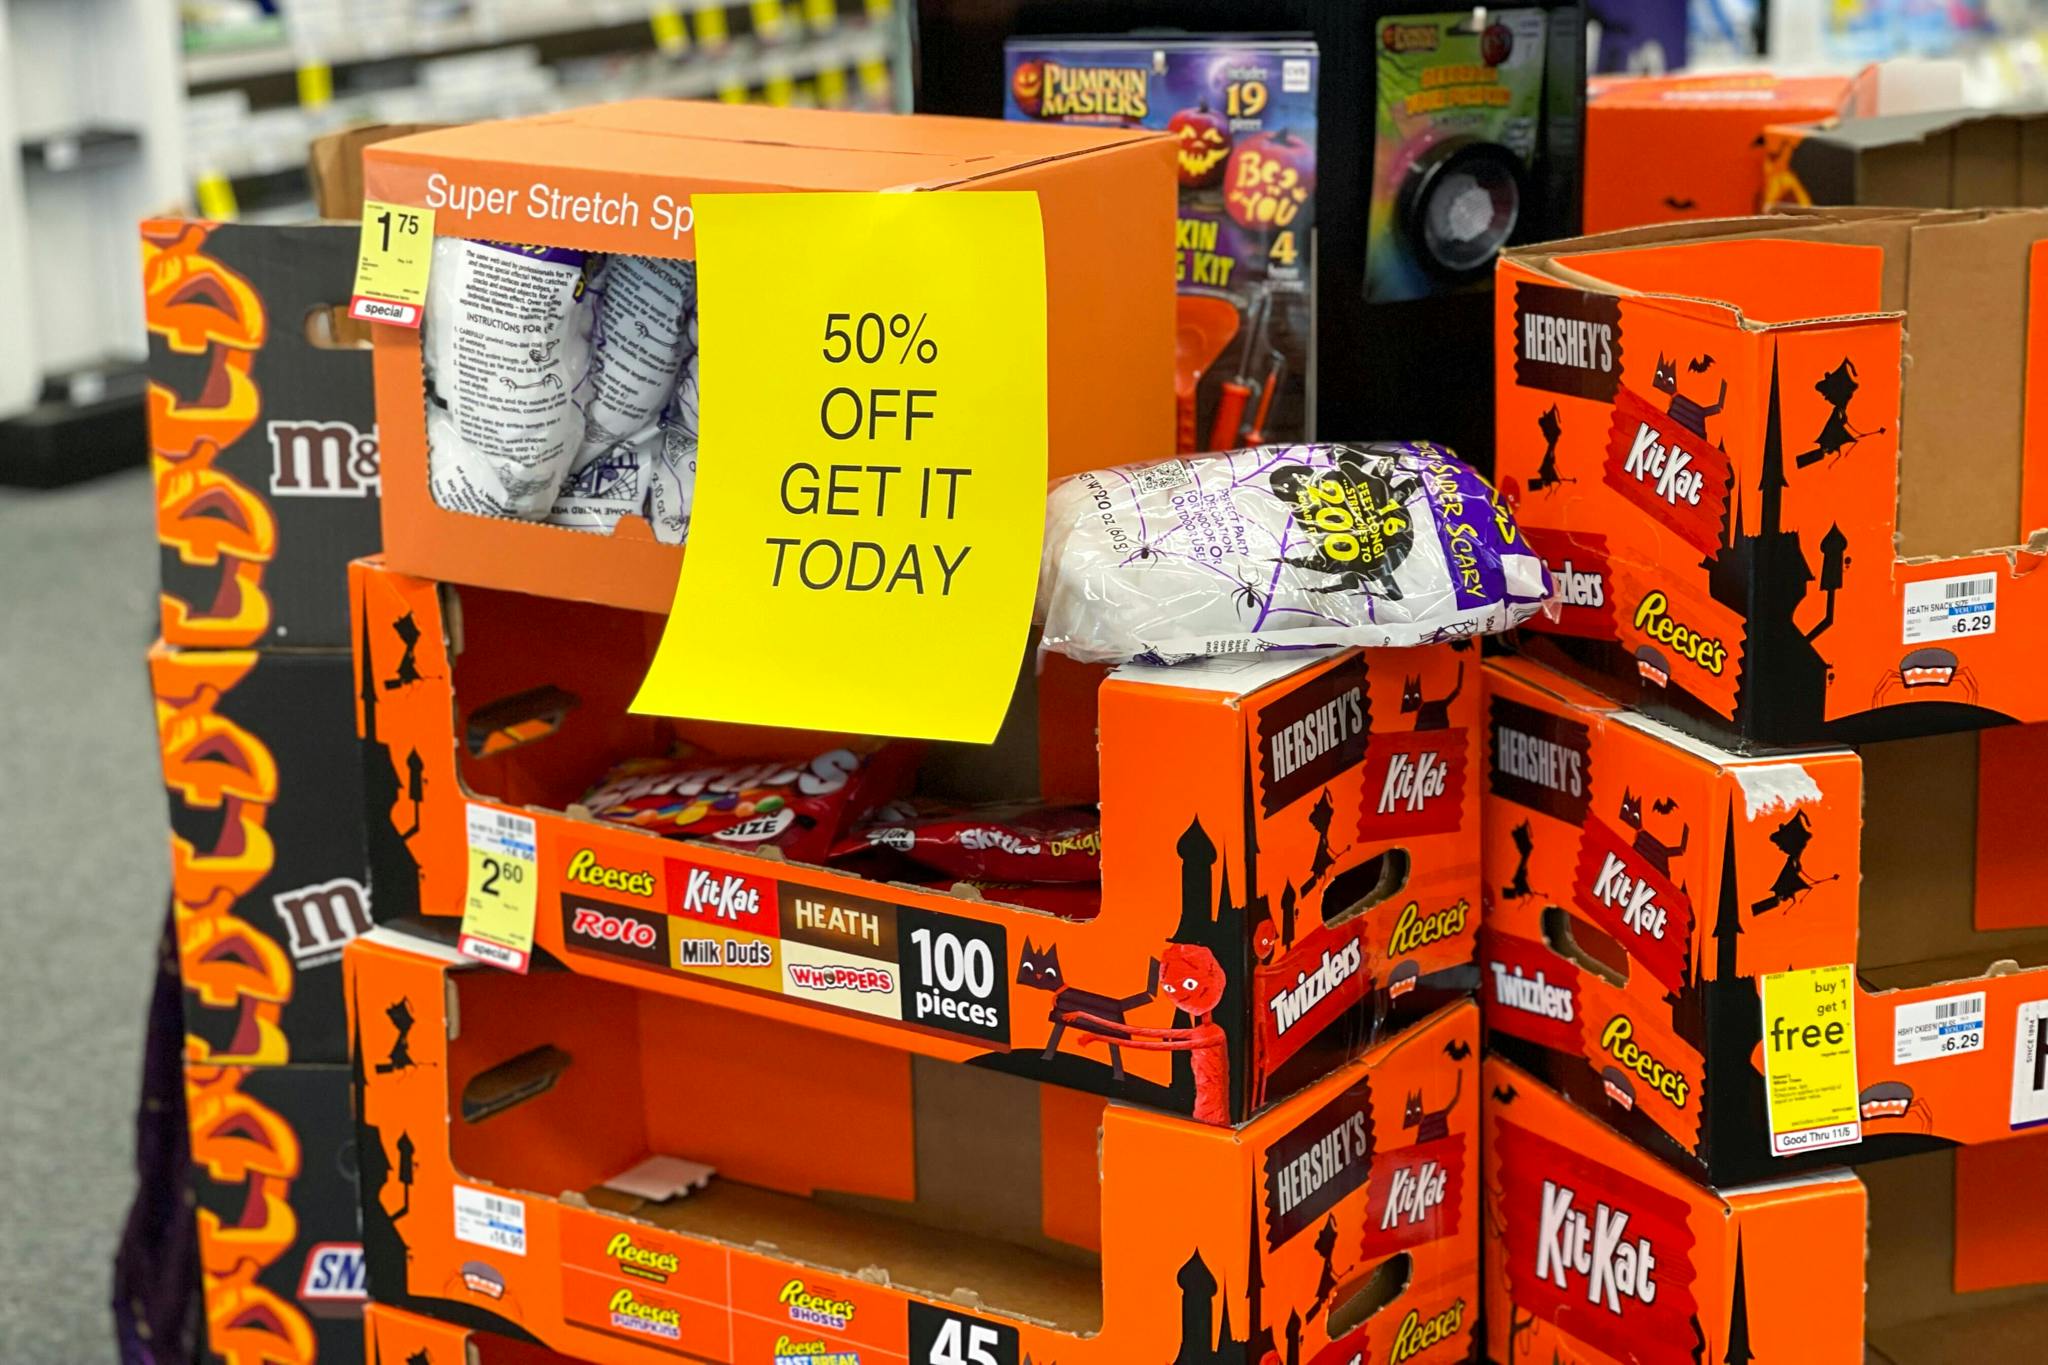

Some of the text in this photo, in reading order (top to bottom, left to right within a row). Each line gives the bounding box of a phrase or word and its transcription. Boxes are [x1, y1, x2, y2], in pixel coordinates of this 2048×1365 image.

[1043, 62, 1147, 98] PUMPKIN
[1226, 81, 1268, 117] 19
[1041, 91, 1148, 118] MASTERS
[425, 173, 695, 240] Super Stretch Sp
[1176, 218, 1218, 251] KIN
[1269, 231, 1296, 264] 4
[1193, 252, 1235, 287] KIT
[365, 303, 404, 318] special
[466, 312, 520, 334] INSTRUCTIONS
[523, 324, 542, 334] FOR
[822, 311, 938, 365] 50%
[1524, 312, 1613, 373] HERSHEY'S
[820, 386, 937, 441] OFF
[269, 421, 379, 496] m&
[780, 461, 972, 520] GET IT
[1306, 479, 1361, 563] 200
[1378, 497, 1402, 537] 16
[1232, 525, 1250, 558] PARTY
[1444, 522, 1488, 598] SCARY
[765, 537, 972, 596] TODAY
[1557, 560, 1604, 608] zlers
[1906, 604, 1929, 615] HEATH
[1951, 615, 1992, 633] $6.29
[1634, 592, 1728, 675] Reese's
[1271, 686, 1363, 783] HERSHEY'S
[1499, 725, 1583, 798] HERSHEY'S
[721, 819, 777, 836] SIZE
[567, 849, 656, 897] Reese's
[795, 899, 880, 946] HEATH
[1388, 901, 1470, 957] Reese's
[473, 943, 511, 962] special
[682, 939, 771, 965] Milk Duds
[911, 928, 995, 998] 100
[788, 964, 894, 993] WHOPPERS
[1269, 937, 1361, 1036] Twizzlers
[1490, 961, 1575, 1023] Twizzlers
[1815, 978, 1847, 994] buy 1
[916, 989, 998, 1028] pieces
[1817, 1000, 1848, 1017] get 1
[1770, 1016, 1845, 1052] free
[1941, 1032, 1980, 1052] $6.29
[1601, 1016, 1690, 1107] Reese's
[1783, 1127, 1851, 1146] Good Thru 11/5
[1277, 1111, 1367, 1217] HERSHEY'S
[606, 1233, 680, 1273] Reese's
[608, 1288, 681, 1328] Reese's
[779, 1279, 856, 1321] Reese's
[775, 1335, 826, 1357] Reese's
[929, 1317, 999, 1365] 45
[1389, 1299, 1466, 1365] Reese's
